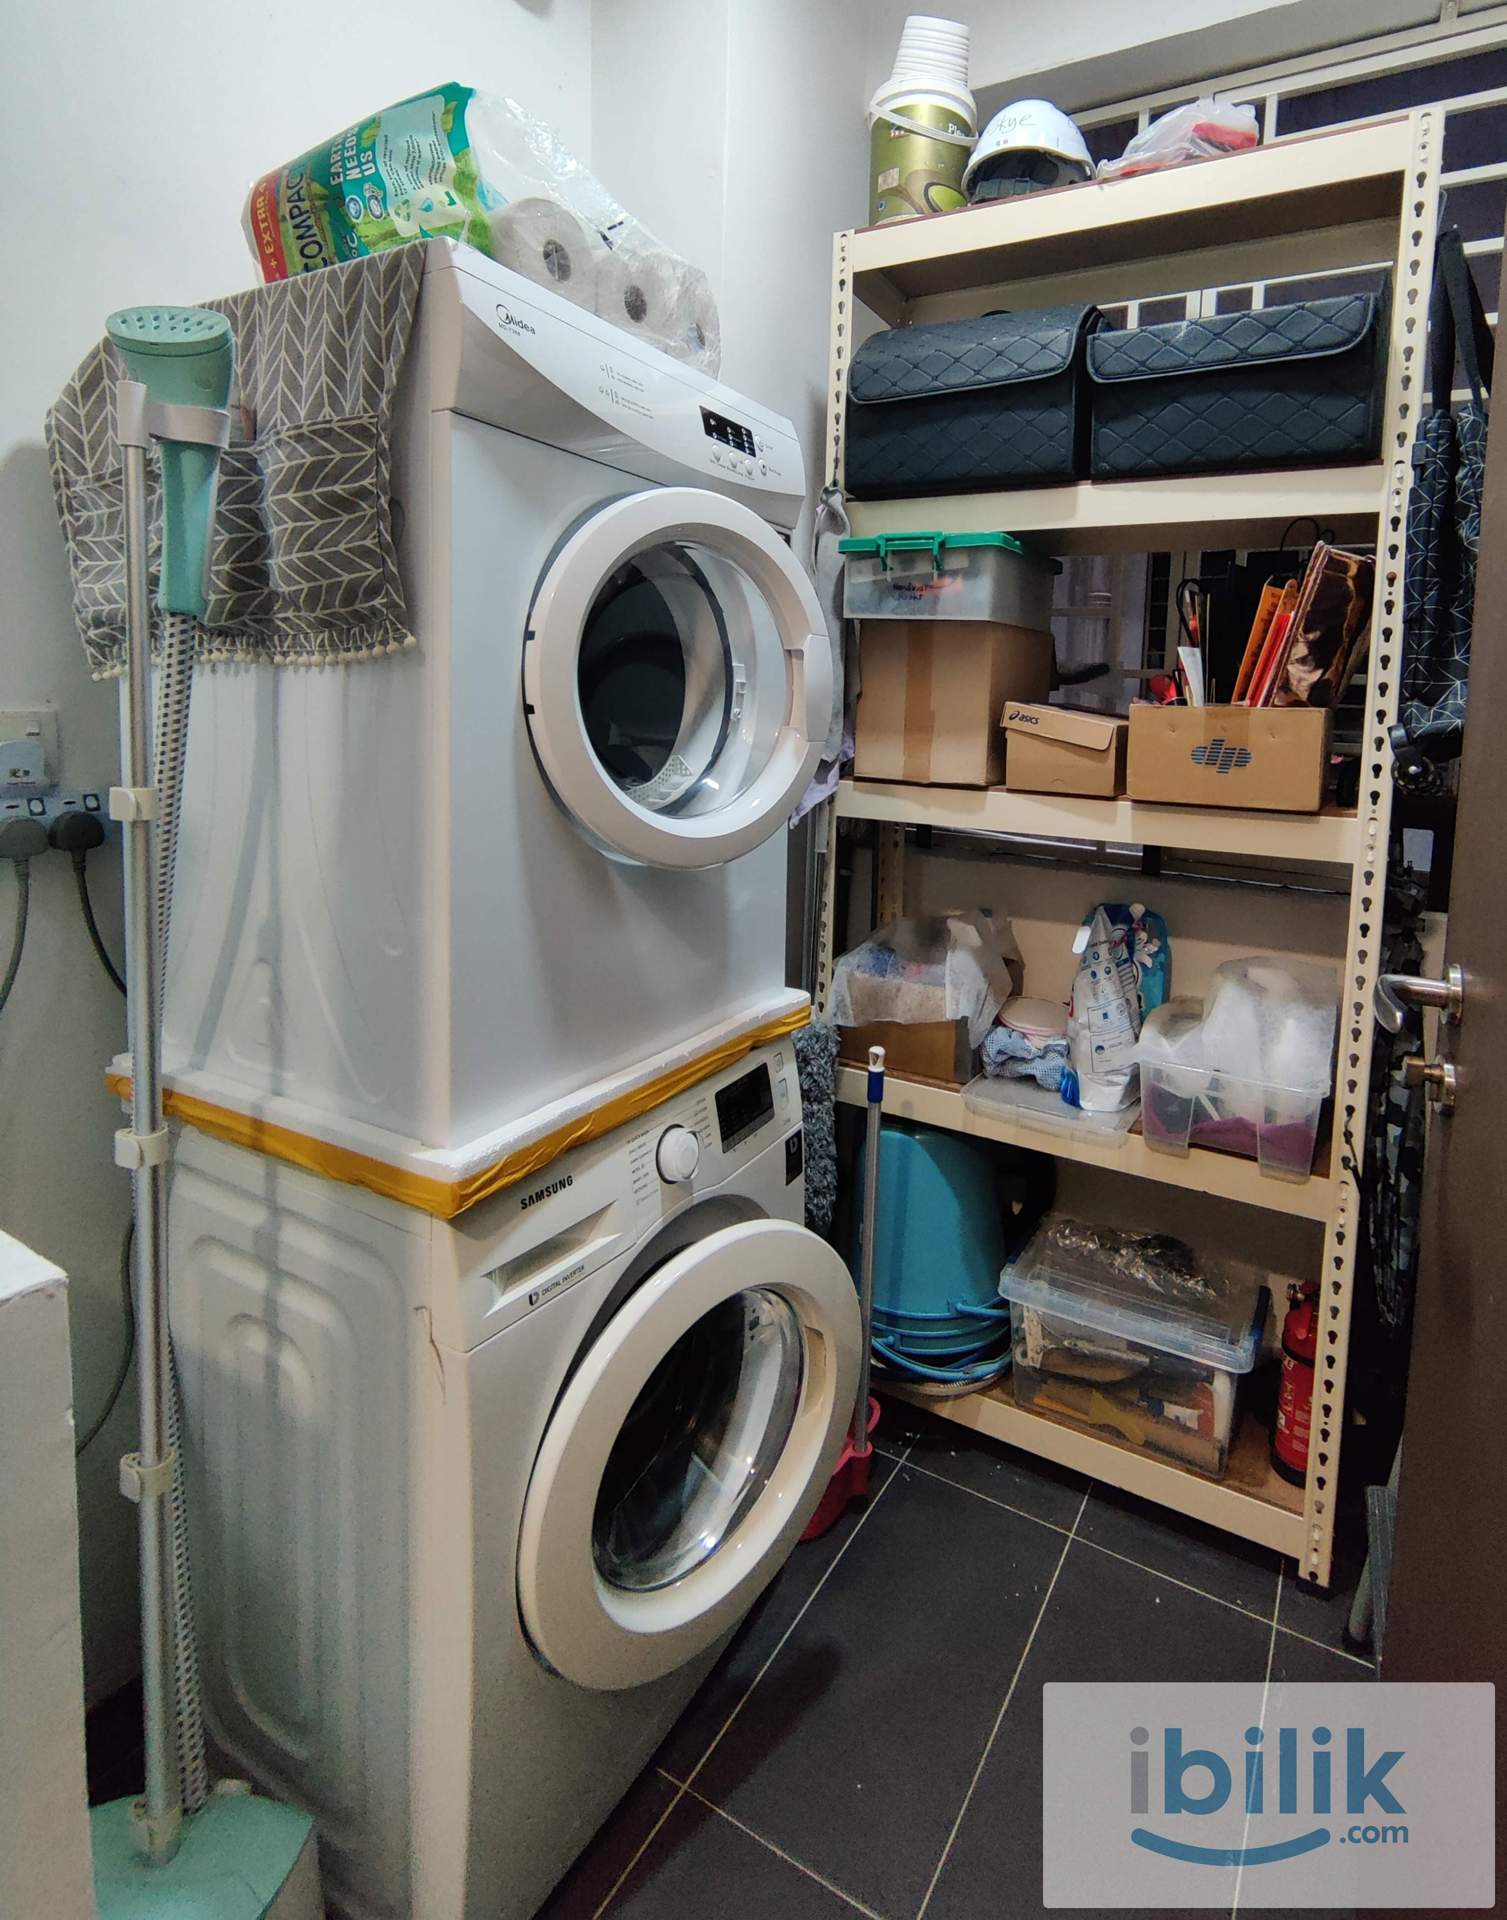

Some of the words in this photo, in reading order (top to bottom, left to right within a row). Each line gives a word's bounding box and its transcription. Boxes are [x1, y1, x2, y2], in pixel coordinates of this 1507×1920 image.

[361, 150, 376, 177] US
[255, 195, 275, 255] EXTRA
[497, 306, 536, 335] Midea
[1019, 713, 1040, 725] asics
[520, 1175, 573, 1210] SAMSUNG
